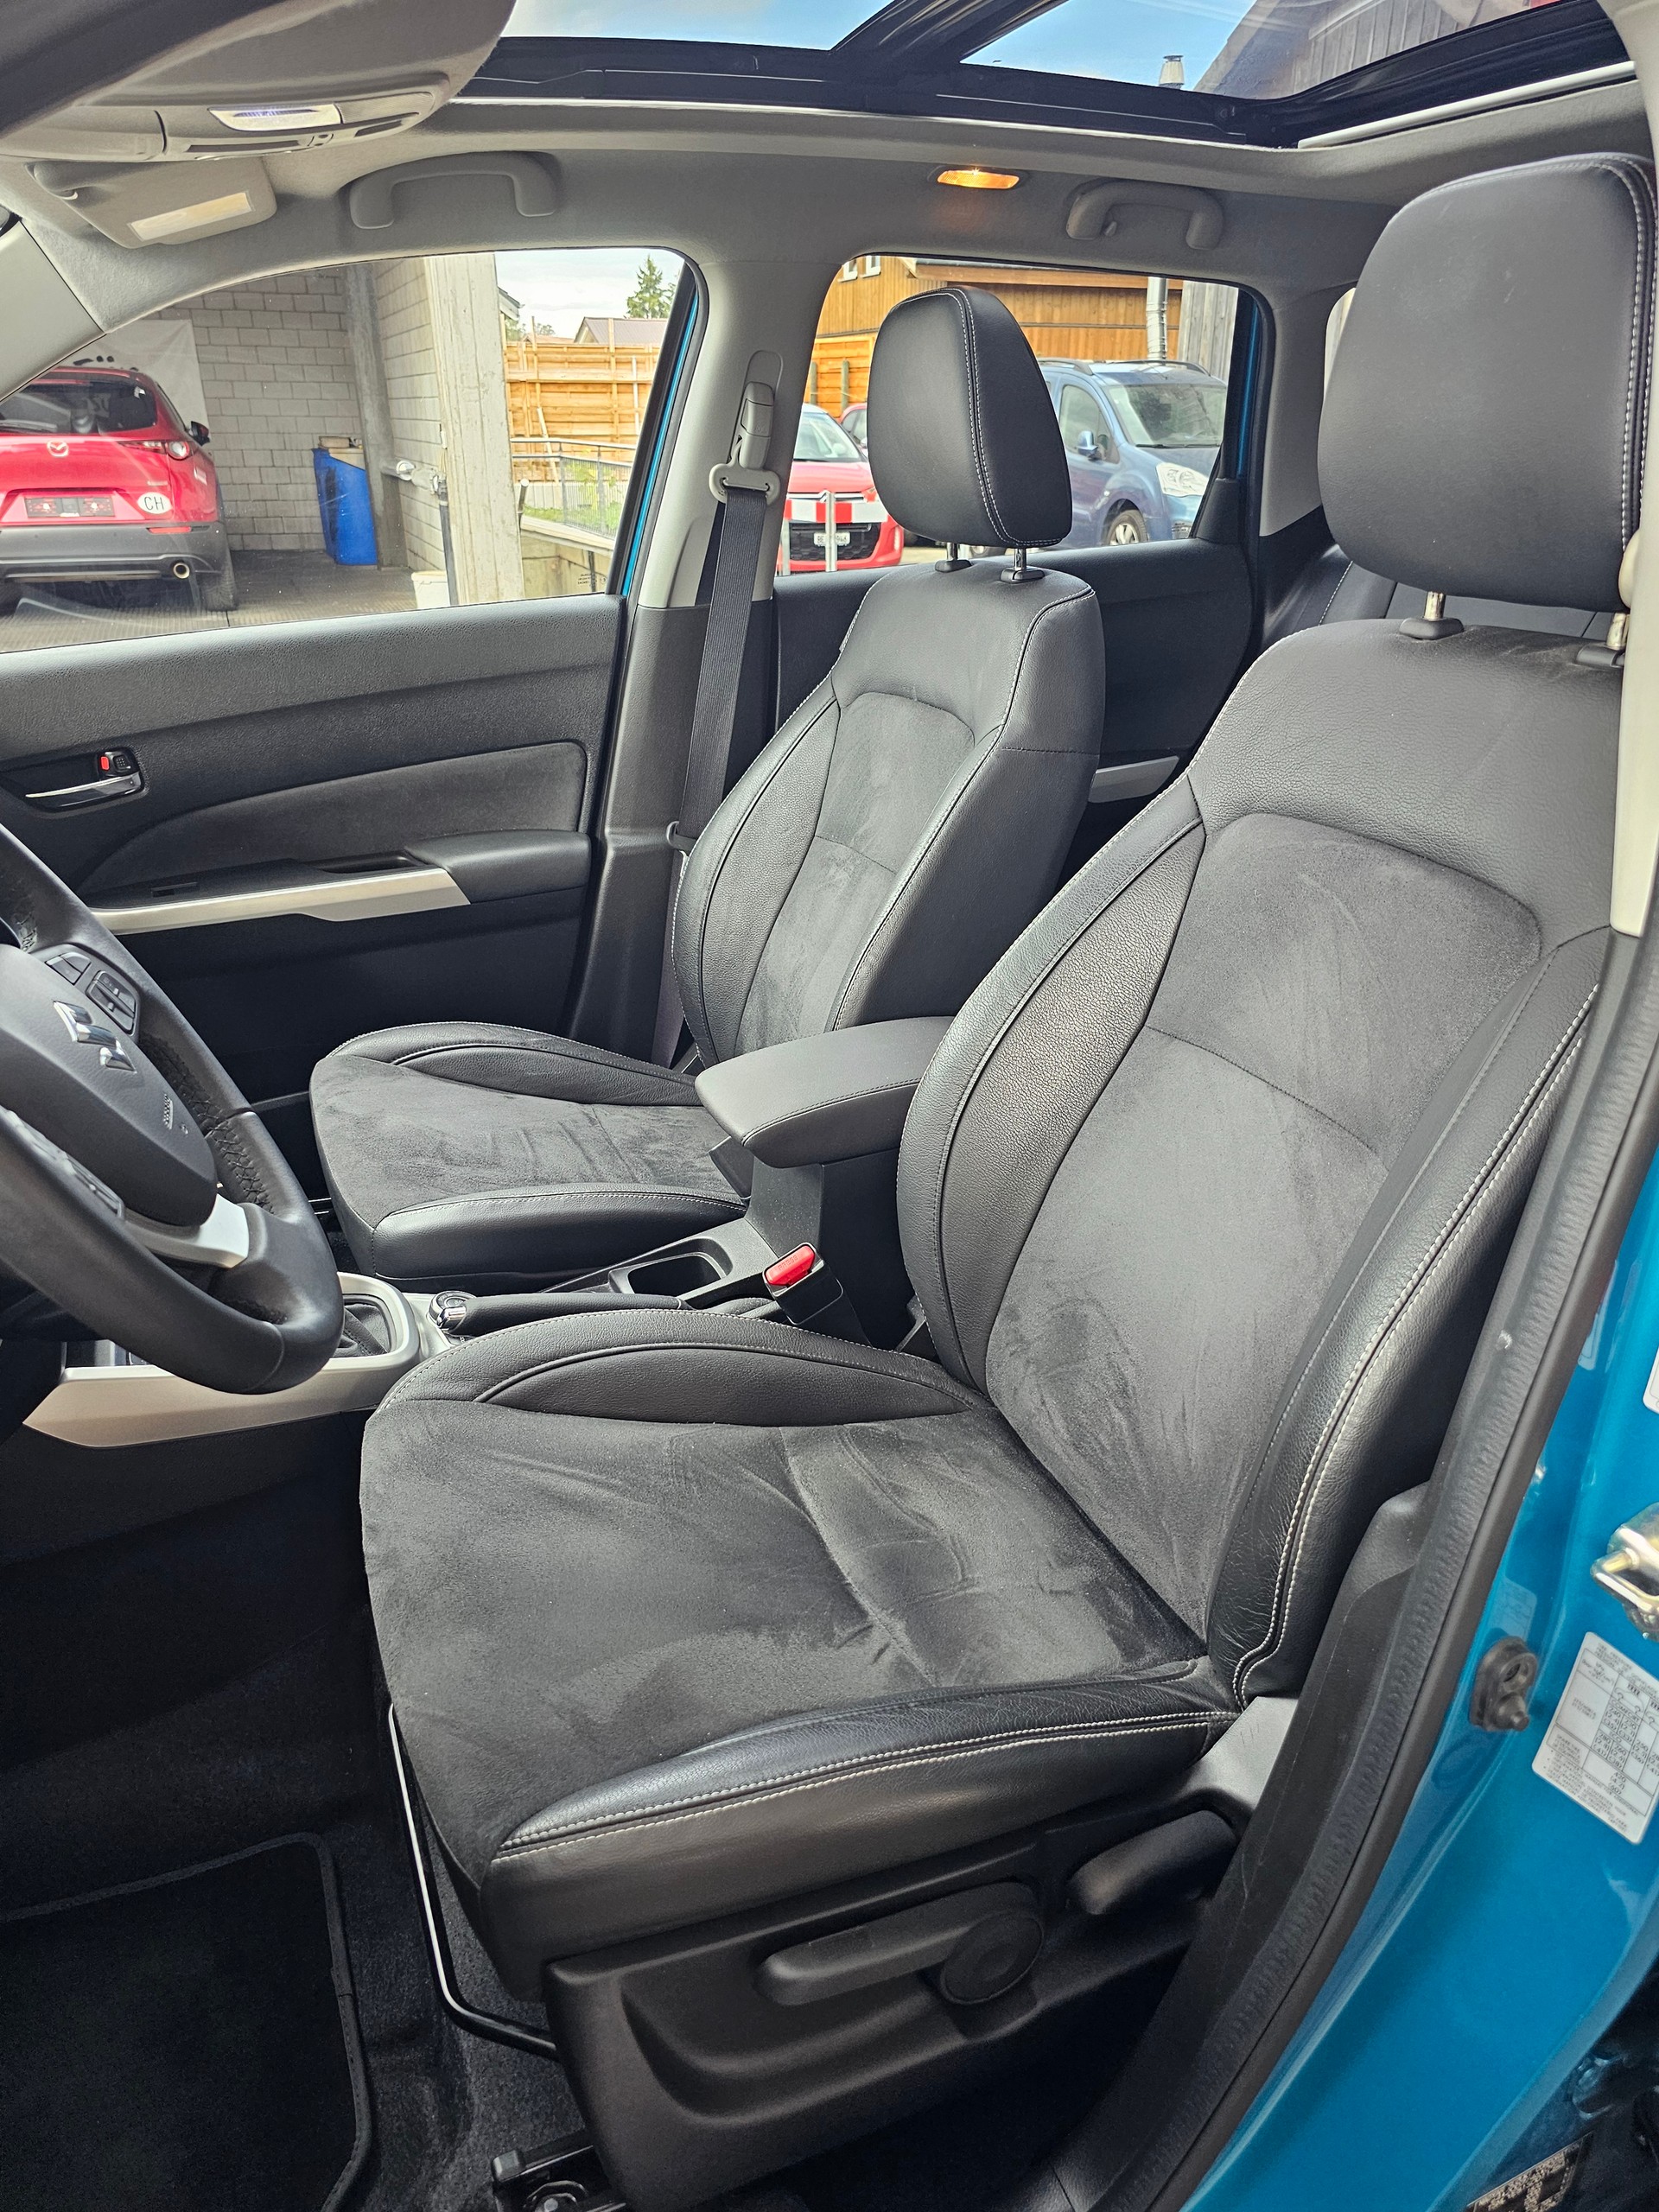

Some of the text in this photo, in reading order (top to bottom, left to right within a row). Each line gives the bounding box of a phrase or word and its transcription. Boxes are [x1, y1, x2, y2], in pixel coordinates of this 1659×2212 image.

[143, 496, 165, 511] CH
[779, 1255, 798, 1270] PRESS
[1608, 1706, 1637, 1730] 240 230
[1599, 1732, 1627, 1756] 280 260
[1613, 1770, 1626, 1783] 420
